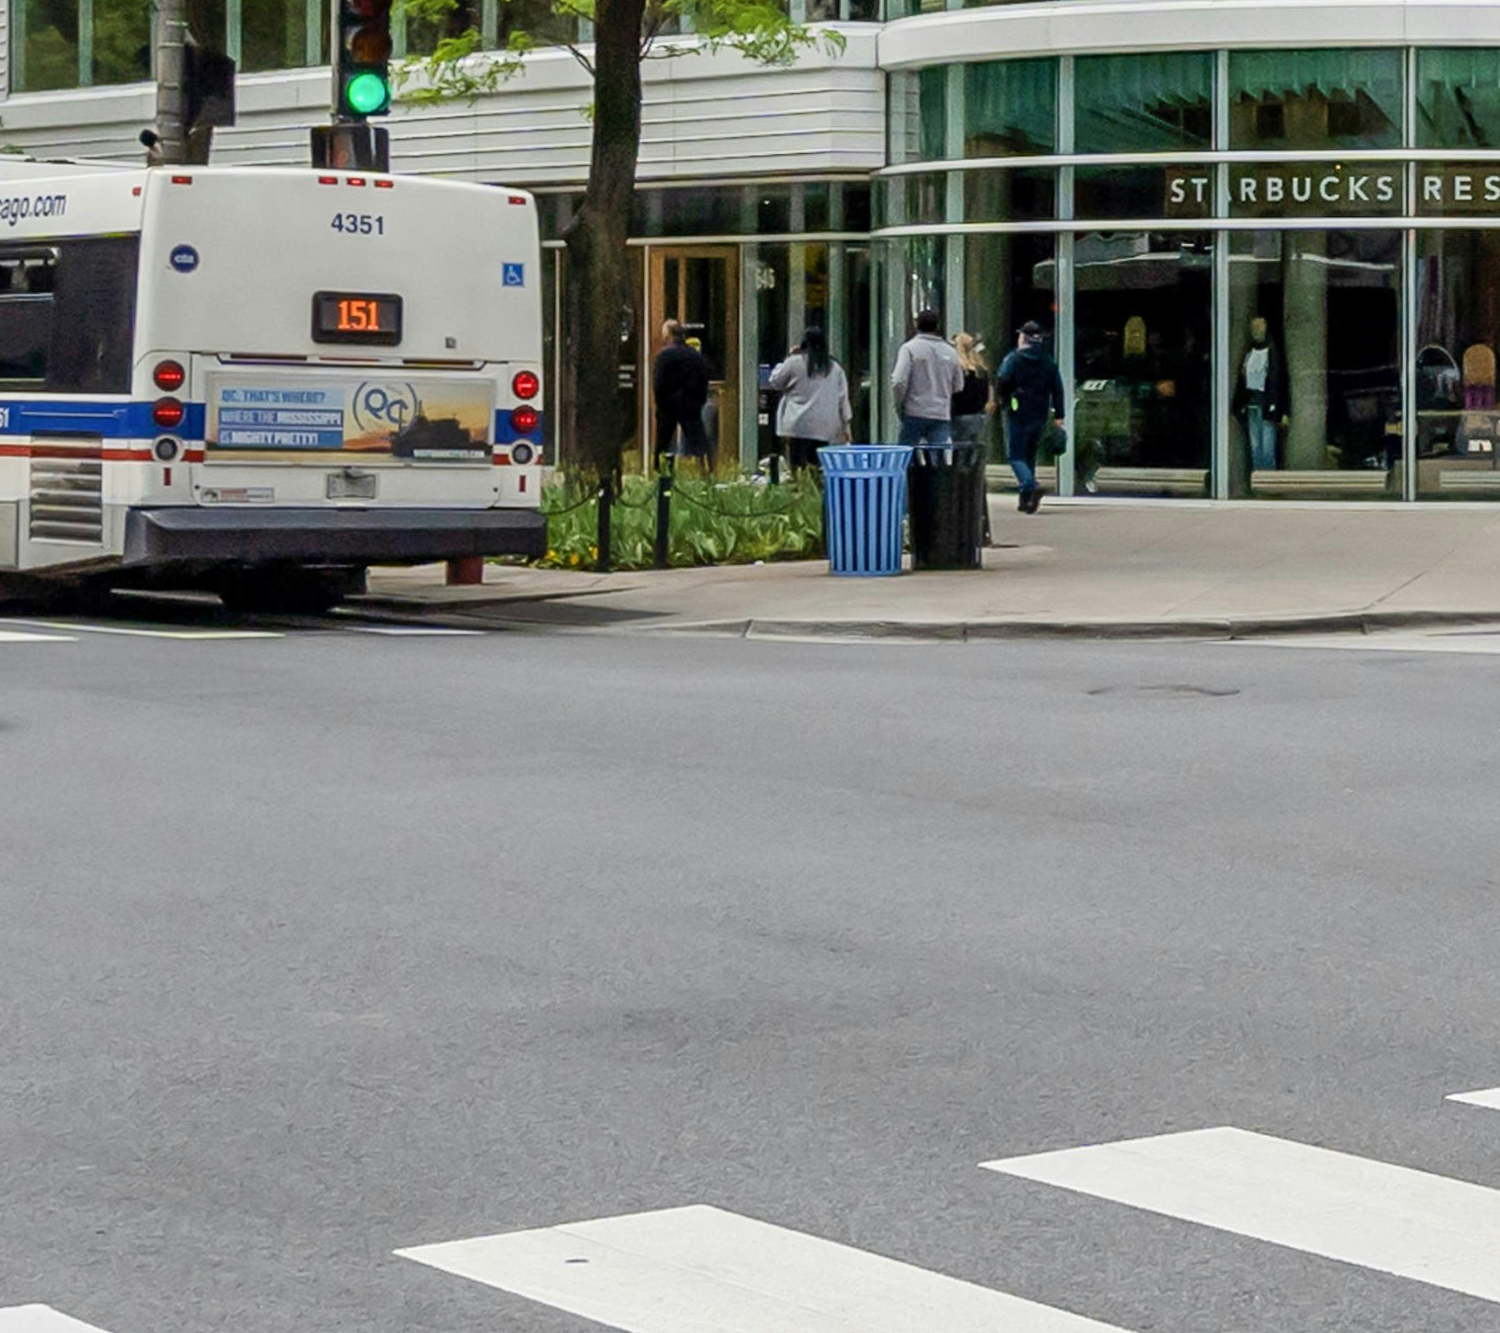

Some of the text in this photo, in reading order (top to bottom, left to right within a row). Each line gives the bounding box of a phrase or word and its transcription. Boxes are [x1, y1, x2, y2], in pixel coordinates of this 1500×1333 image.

[1170, 175, 1394, 203] STRBUCKS
[330, 212, 385, 235] 4351
[337, 299, 380, 331] 151
